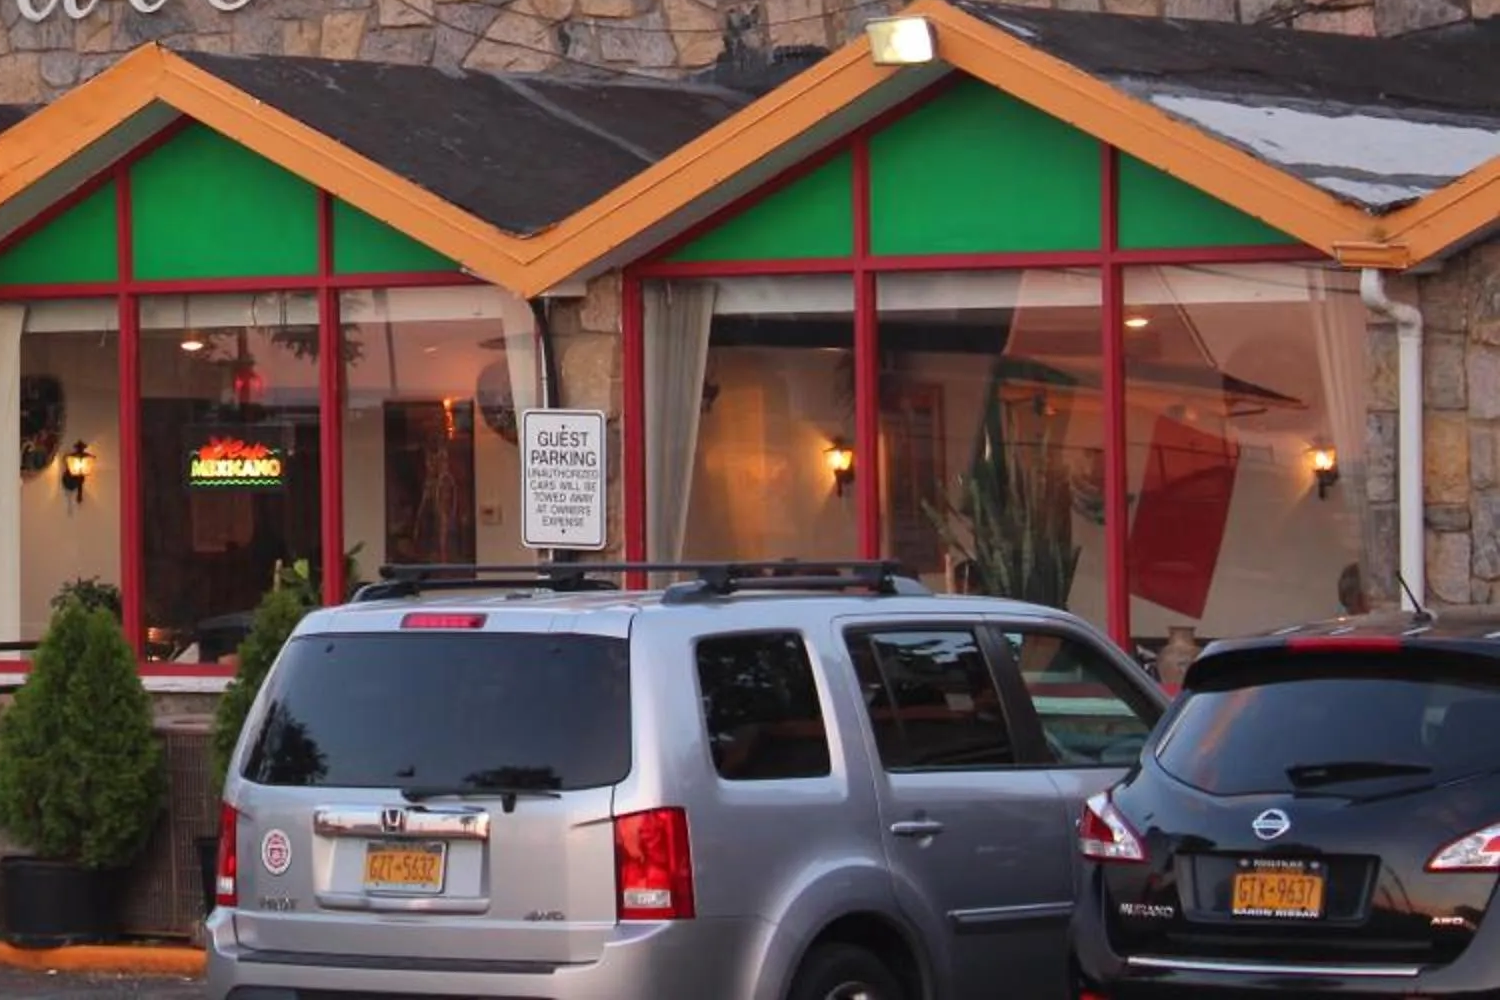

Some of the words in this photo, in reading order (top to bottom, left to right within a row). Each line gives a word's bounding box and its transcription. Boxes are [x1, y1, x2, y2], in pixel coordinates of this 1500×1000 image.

[537, 431, 589, 446] GUEST
[531, 450, 597, 467] PARKING
[527, 469, 598, 479] UNAUTHORIZED
[530, 480, 556, 490] CARS
[559, 481, 581, 491] WILL
[584, 481, 597, 492] BE
[533, 492, 567, 502] TOWED
[569, 493, 595, 503] AWAY
[535, 504, 547, 514] AT
[541, 516, 584, 527] EXPENSE
